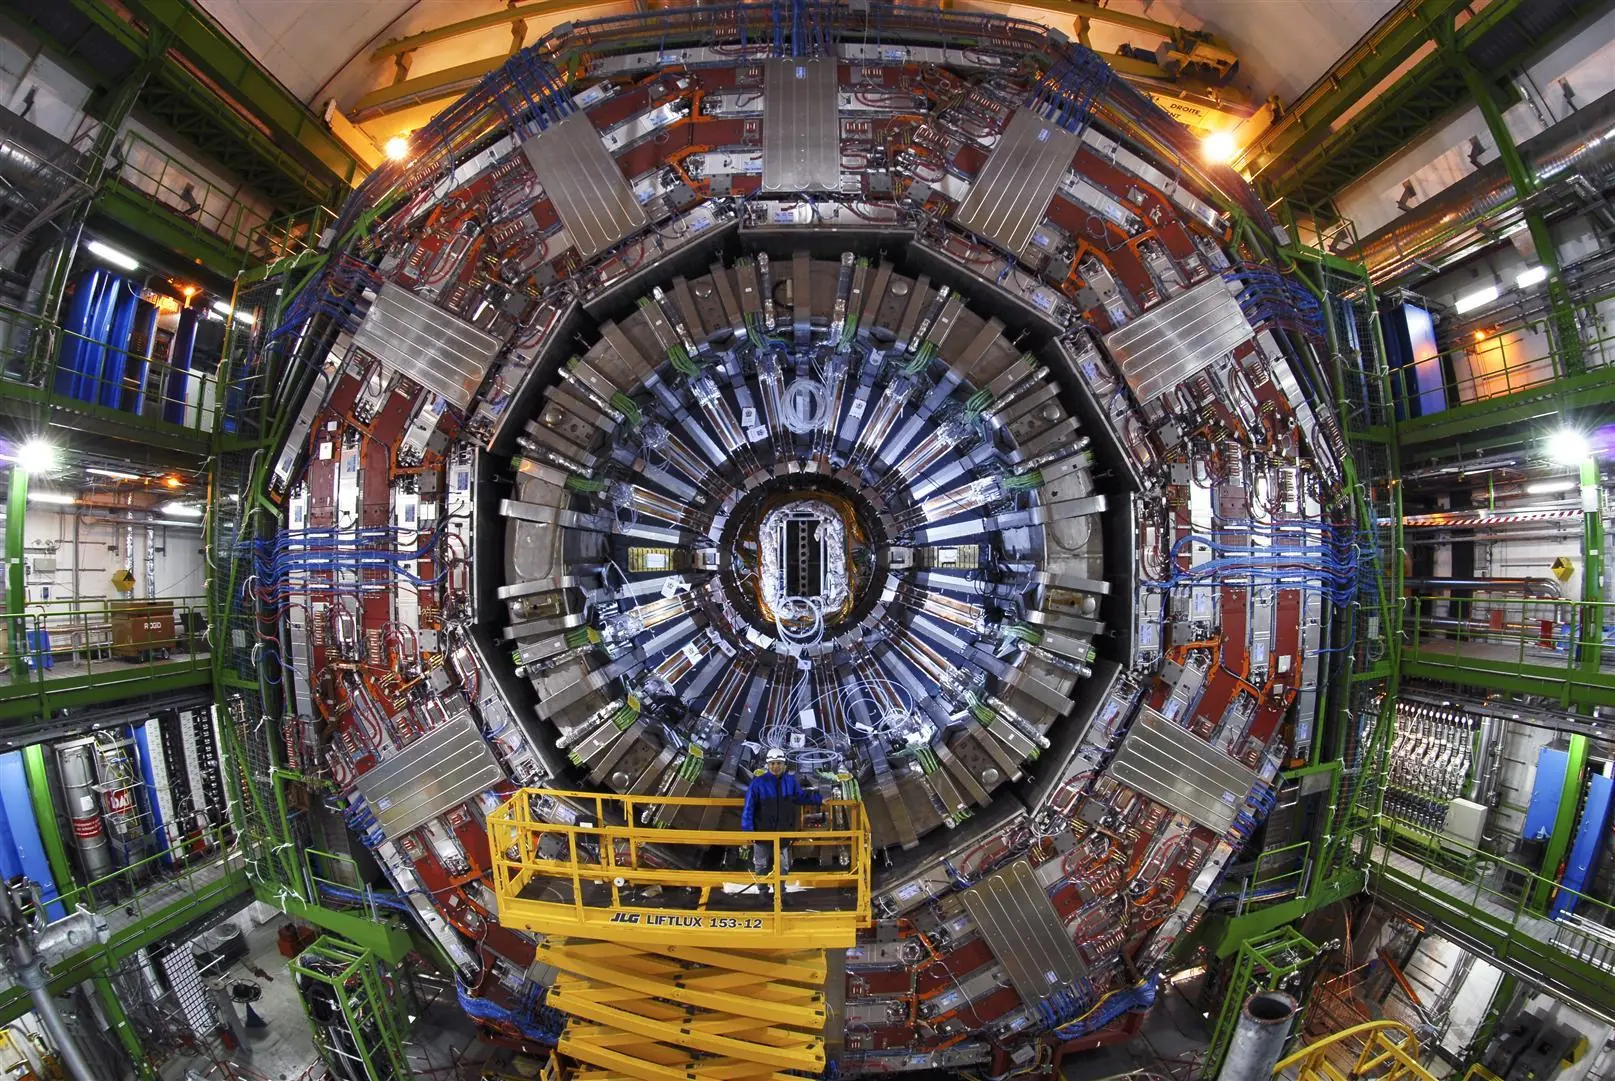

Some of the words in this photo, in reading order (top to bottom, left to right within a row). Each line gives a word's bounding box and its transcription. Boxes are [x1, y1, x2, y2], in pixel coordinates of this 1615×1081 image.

[610, 912, 640, 924] JLG
[646, 914, 702, 927] LIFTLUX
[709, 917, 763, 929] 153-12
